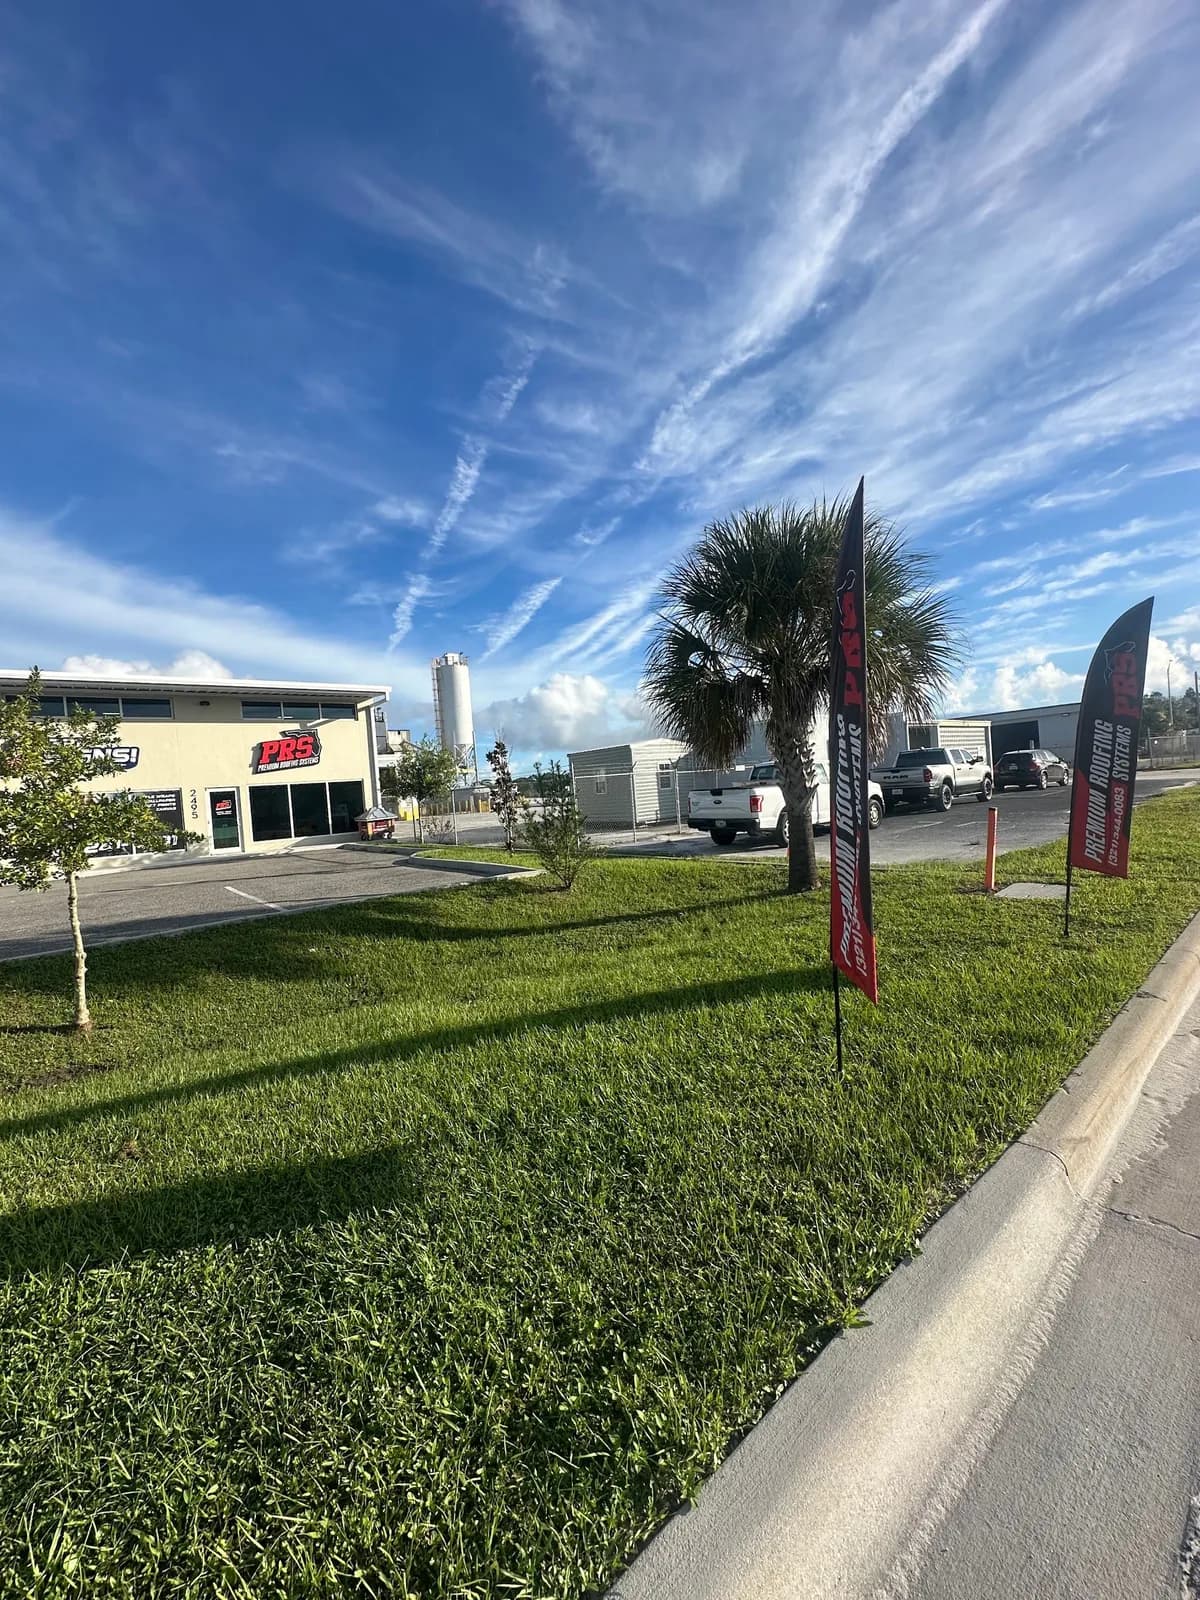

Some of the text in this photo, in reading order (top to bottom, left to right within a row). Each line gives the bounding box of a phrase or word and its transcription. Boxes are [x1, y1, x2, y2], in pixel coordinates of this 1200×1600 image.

[1112, 653, 1141, 719] PRS
[259, 736, 314, 764] PRS
[300, 757, 319, 766] SYSTEMS
[1112, 725, 1132, 781] SYSTEMS
[190, 789, 198, 819] 2495
[1084, 719, 1113, 863] PREMIUM ROOFING
